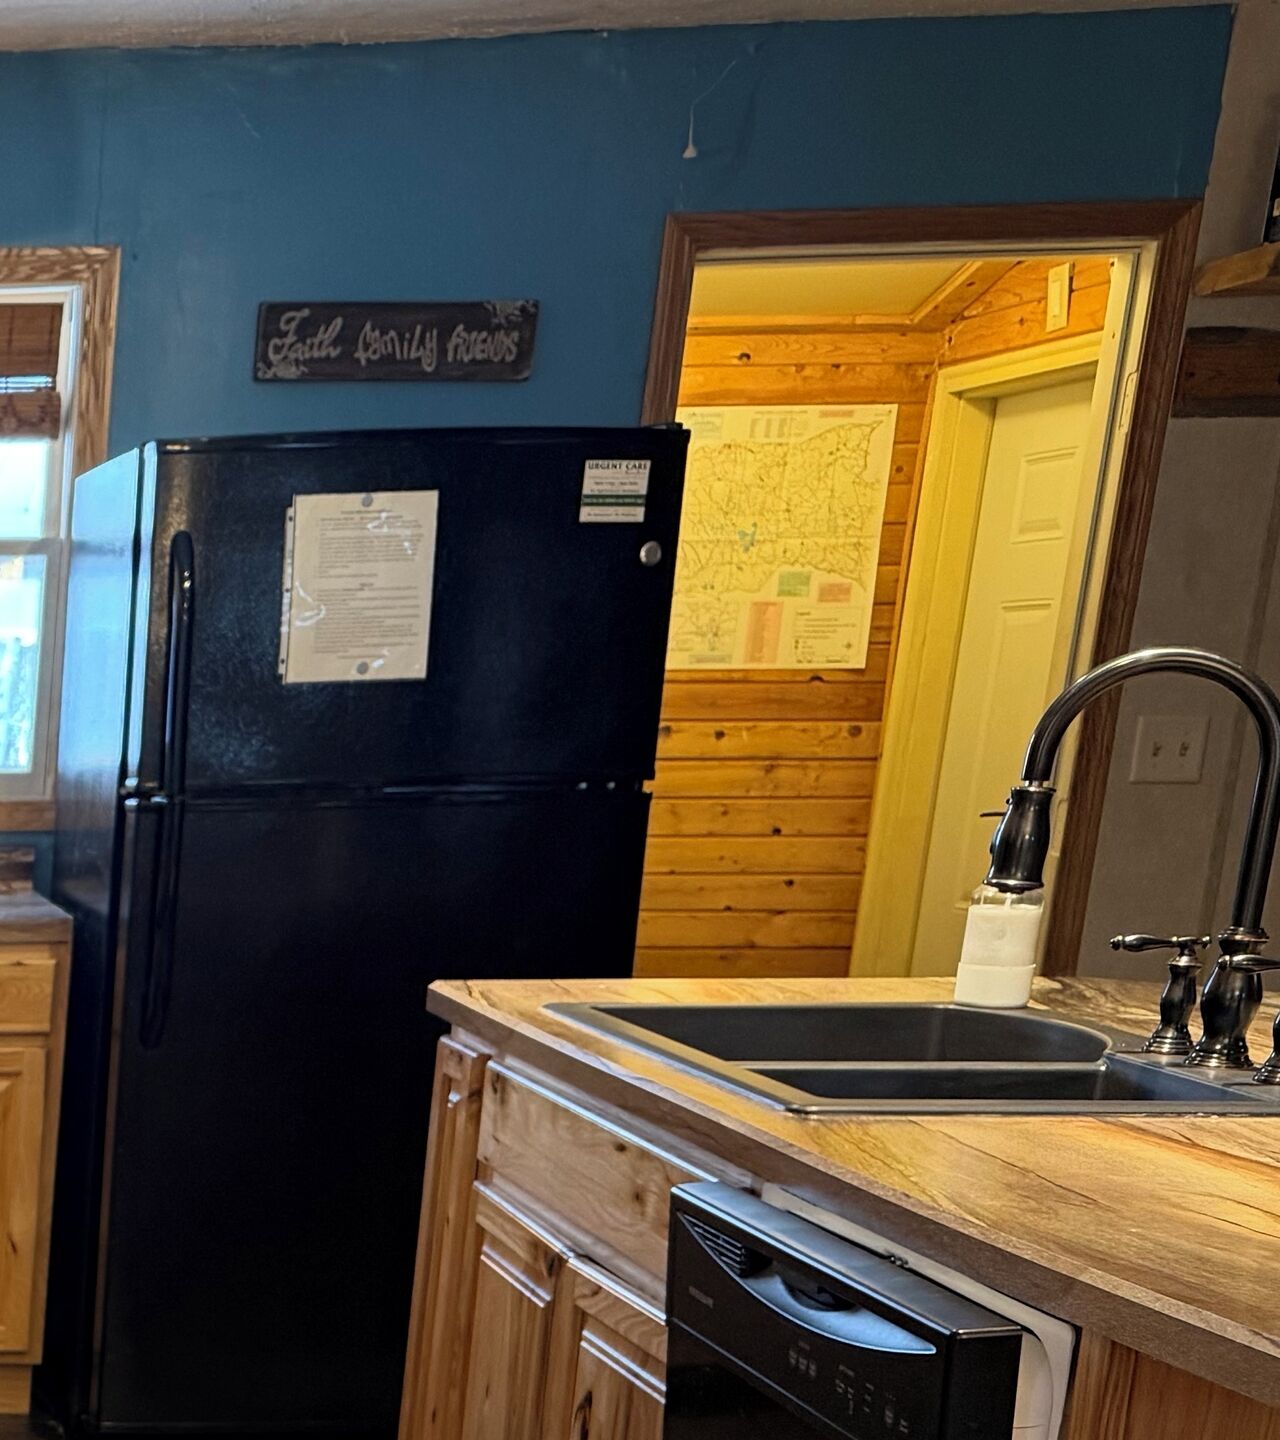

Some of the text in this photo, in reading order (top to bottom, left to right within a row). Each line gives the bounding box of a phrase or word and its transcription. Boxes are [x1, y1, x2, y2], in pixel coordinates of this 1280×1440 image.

[268, 307, 343, 361] Faith
[588, 462, 647, 470] URGENT CARE
